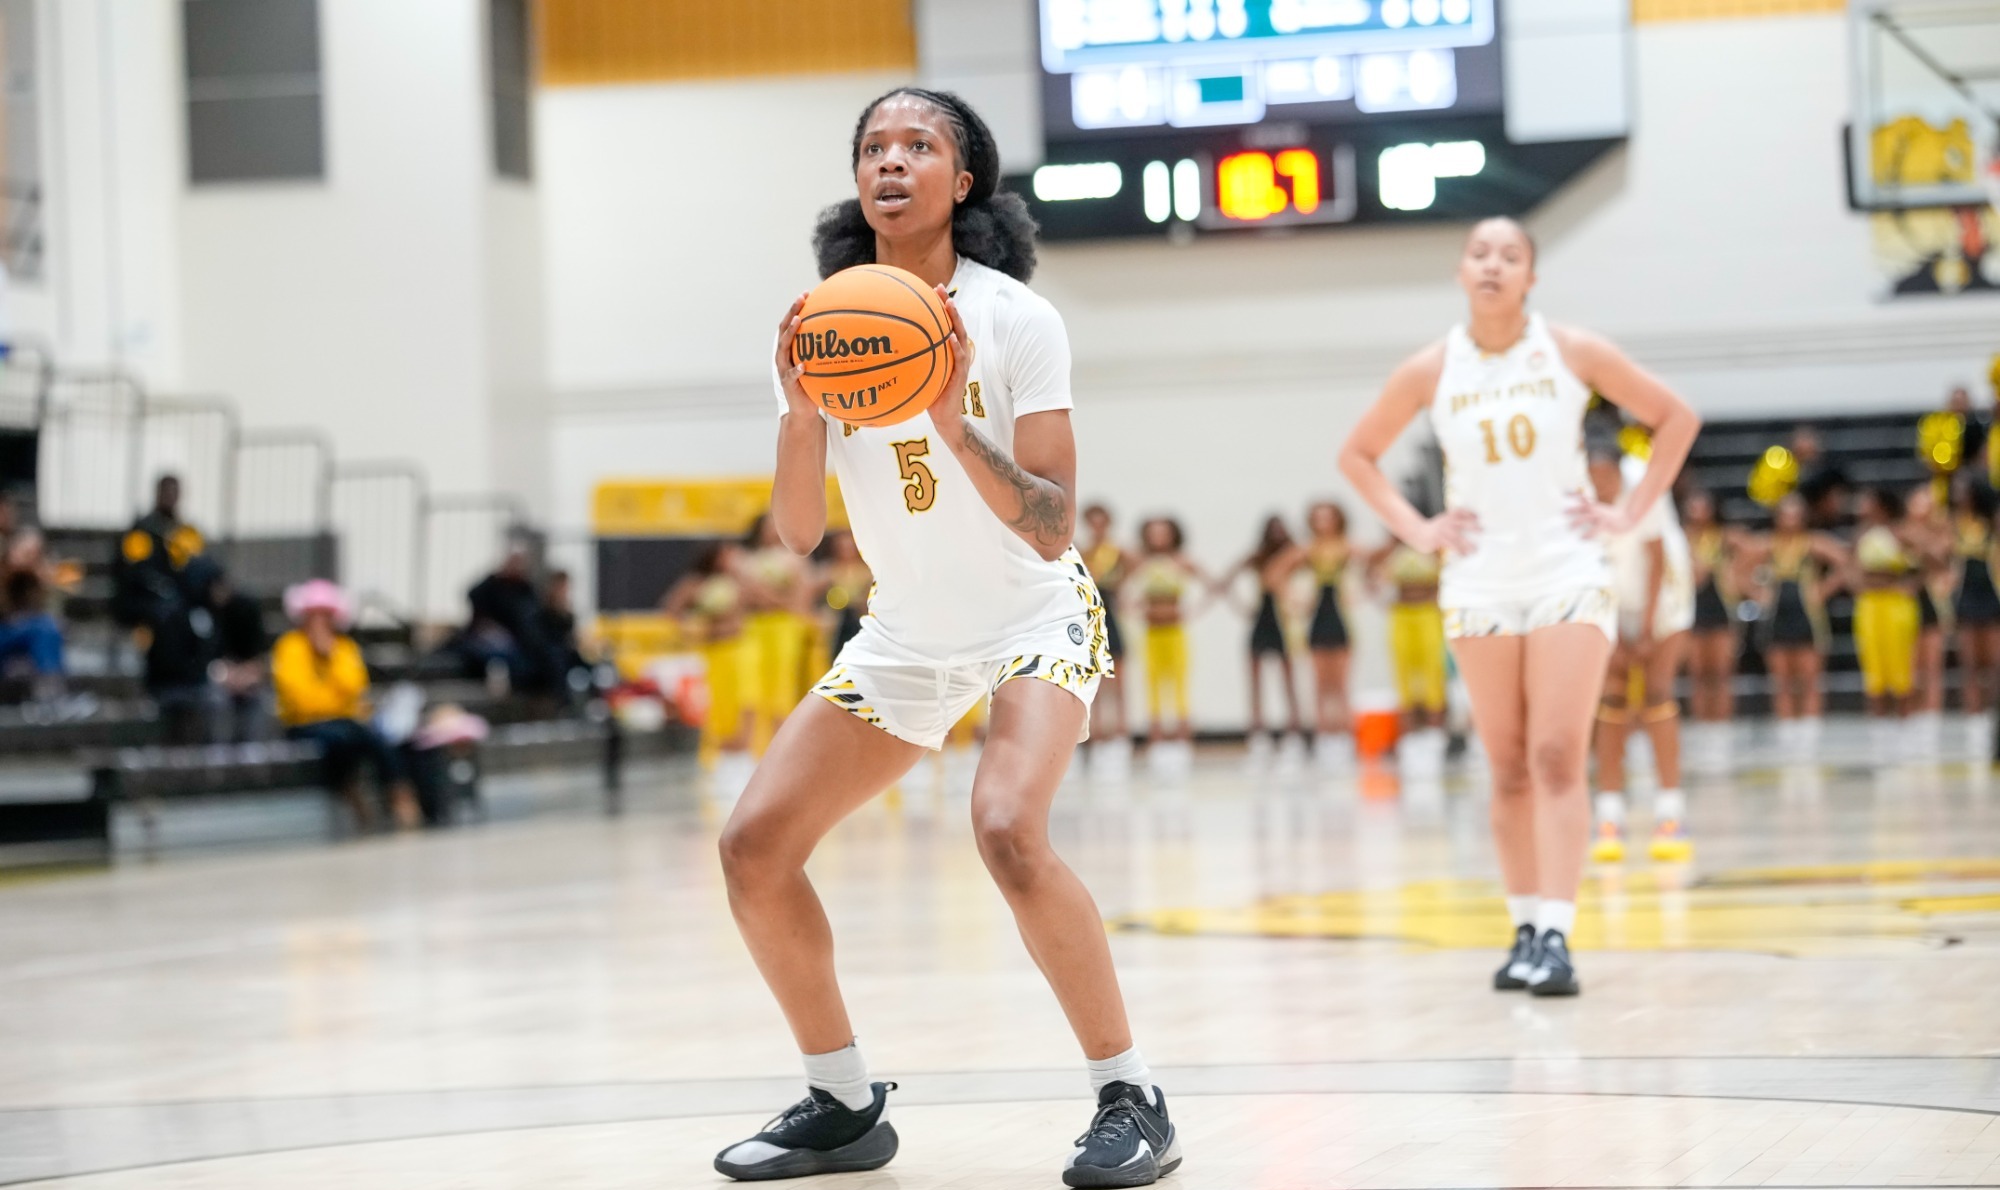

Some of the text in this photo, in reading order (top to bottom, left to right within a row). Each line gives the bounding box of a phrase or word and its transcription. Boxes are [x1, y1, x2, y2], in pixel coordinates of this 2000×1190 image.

[796, 329, 893, 362] Wilson
[878, 376, 898, 391] NXT
[1479, 412, 1537, 464] 10
[889, 436, 939, 514] 5
